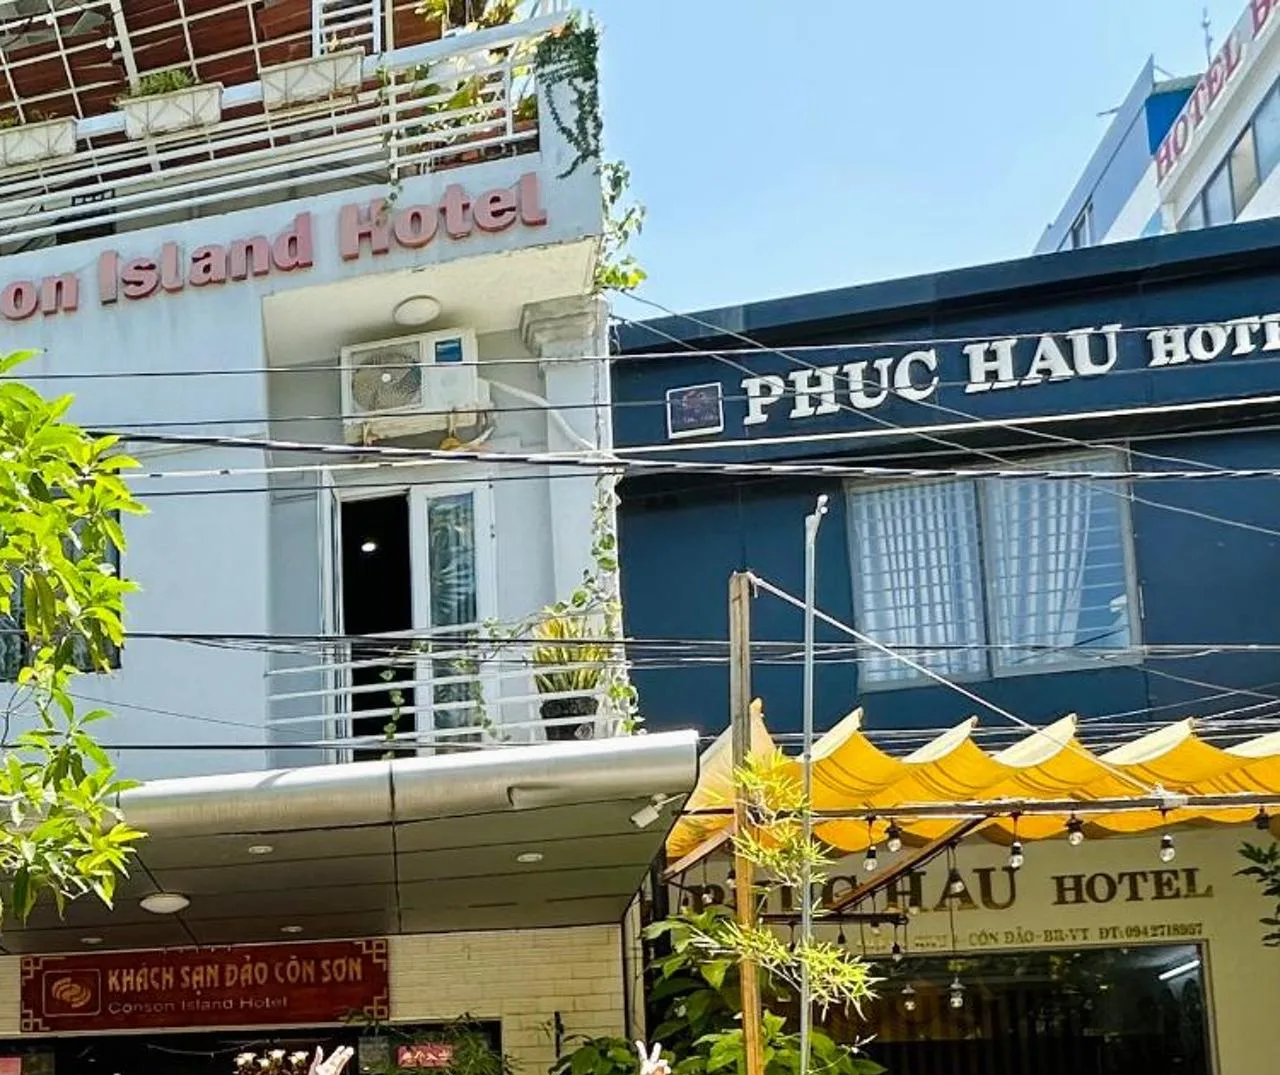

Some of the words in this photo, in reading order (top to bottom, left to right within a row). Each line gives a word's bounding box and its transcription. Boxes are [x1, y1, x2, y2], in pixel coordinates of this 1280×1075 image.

[1156, 35, 1242, 186] HOTEL
[98, 211, 313, 304] Island
[339, 171, 548, 260] Hotel
[740, 348, 939, 426] PHUC
[962, 323, 1123, 394] HAU
[1050, 869, 1214, 905] HOTEL
[107, 963, 175, 993] KHÁCH
[180, 964, 220, 996] SẠN
[108, 1001, 176, 1015] Conson
[182, 997, 234, 1012] Island
[239, 995, 289, 1009] Hotel
